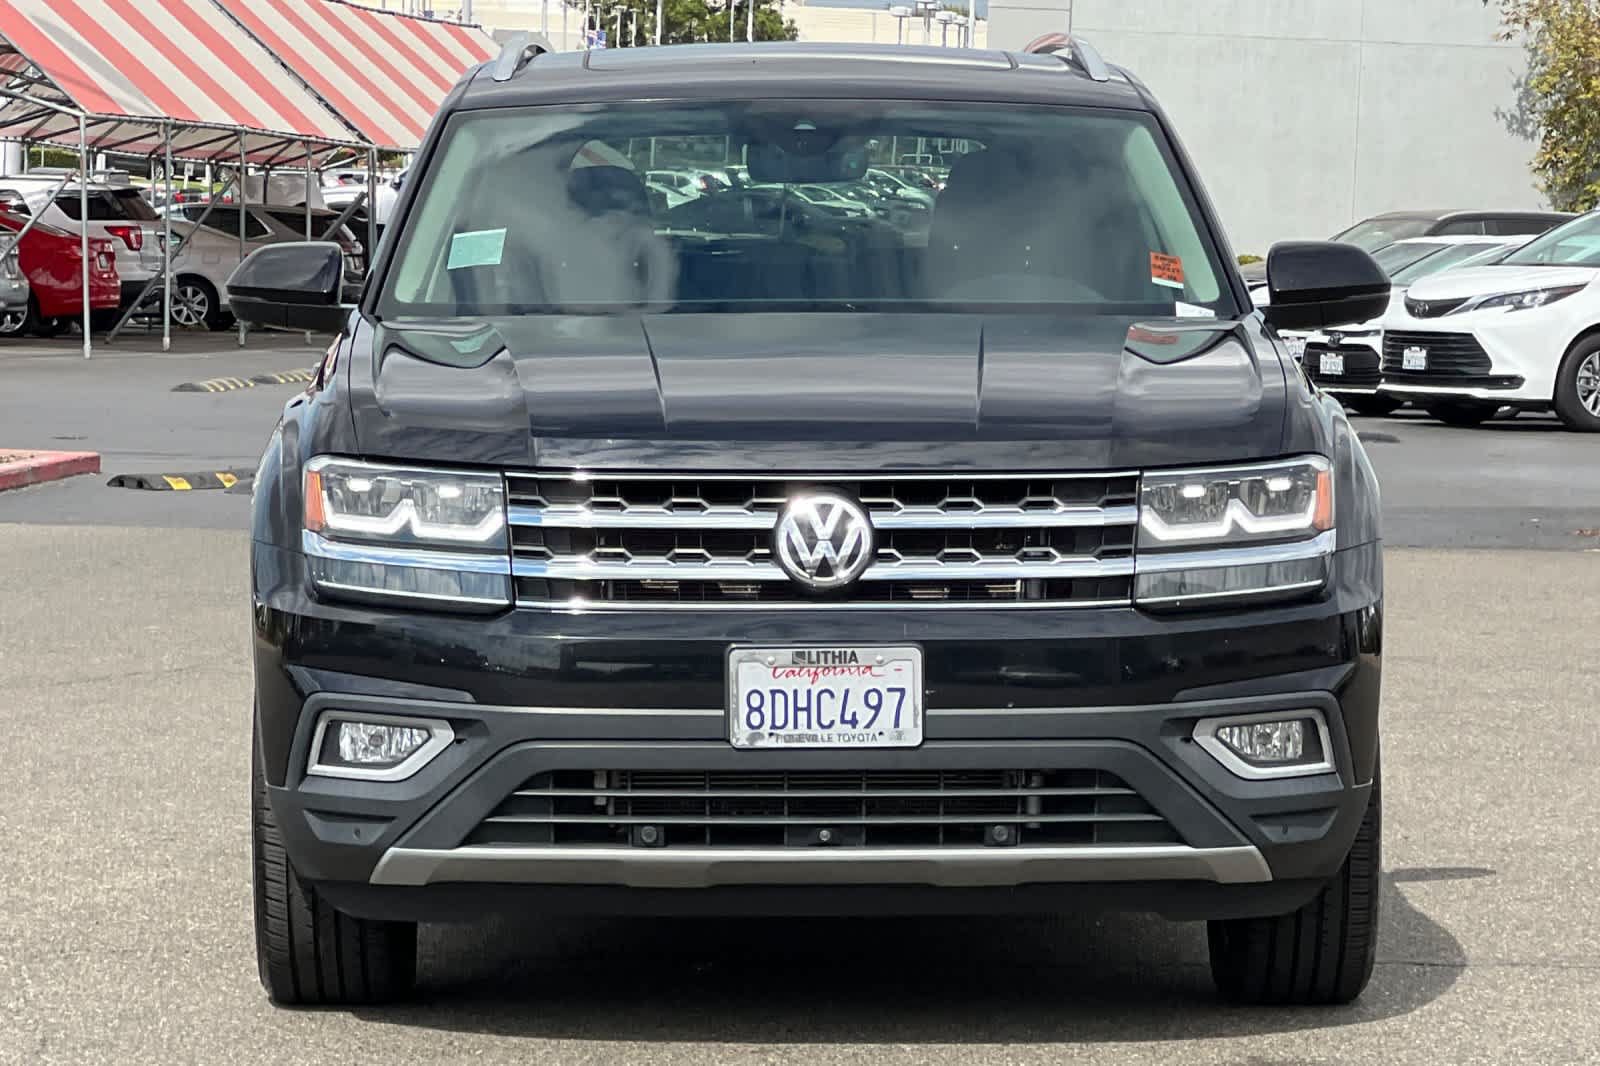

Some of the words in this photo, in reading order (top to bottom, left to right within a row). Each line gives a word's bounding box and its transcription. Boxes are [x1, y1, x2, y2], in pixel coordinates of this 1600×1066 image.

[807, 651, 859, 665] LITHIA
[772, 665, 887, 685] California
[746, 688, 906, 730] 8DHC497
[837, 732, 878, 742] TOYOTA
